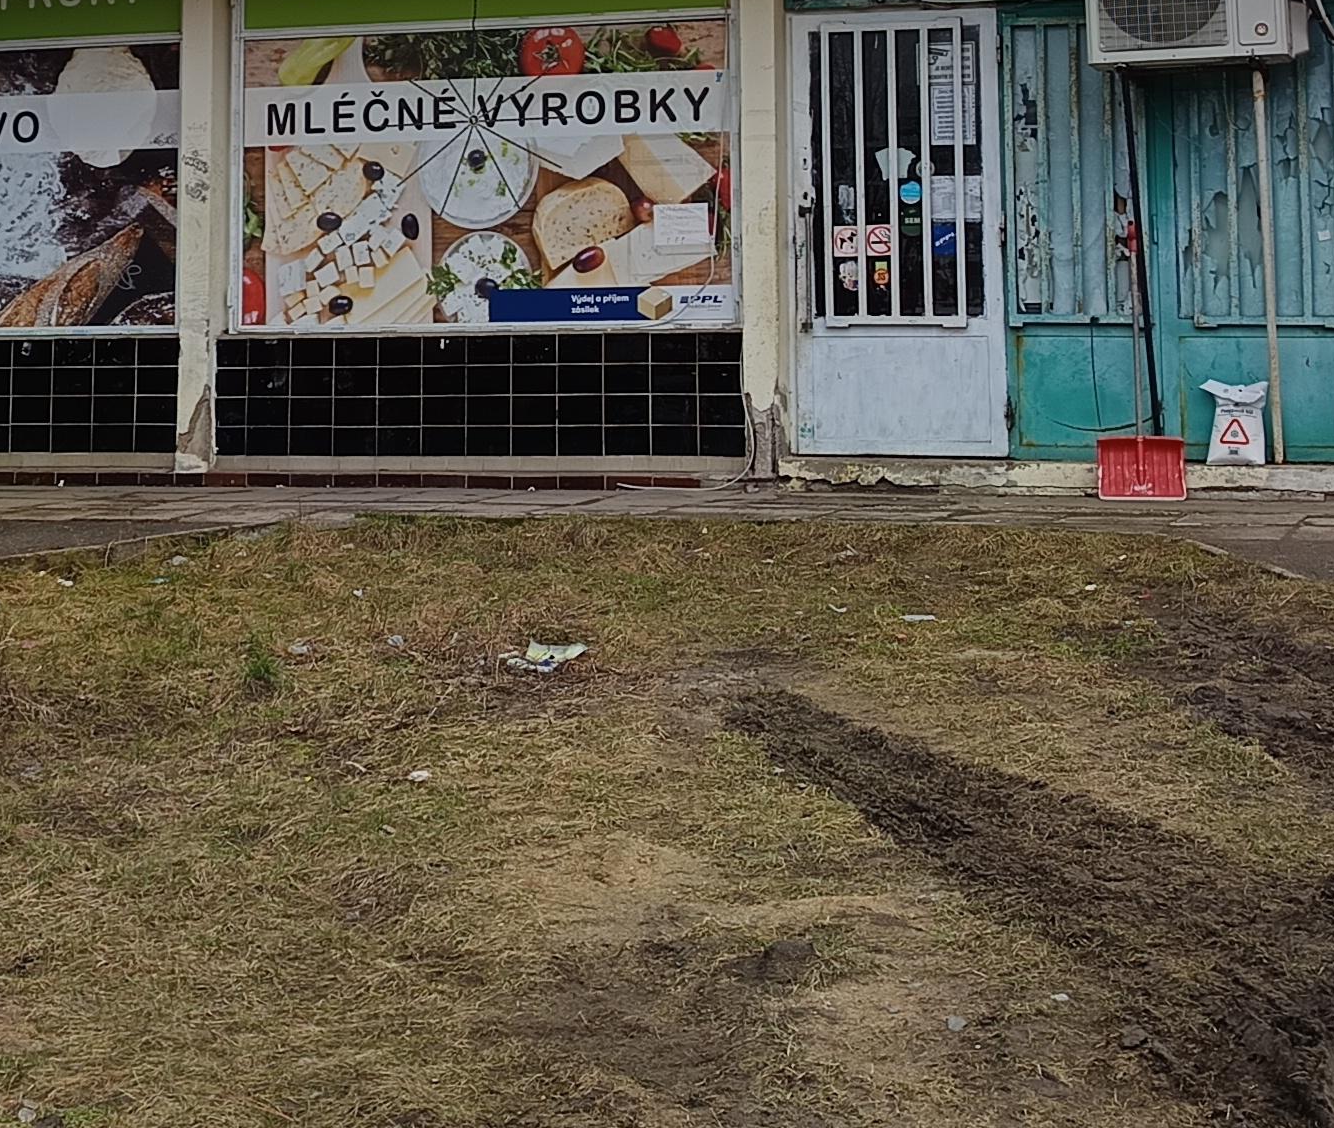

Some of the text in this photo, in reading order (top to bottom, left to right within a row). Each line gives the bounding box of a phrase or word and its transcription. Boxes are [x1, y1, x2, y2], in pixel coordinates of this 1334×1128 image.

[266, 85, 711, 136] MLÉČNÉ VÝROBKY
[571, 294, 594, 304] Výdej
[603, 294, 629, 304] příjem
[571, 305, 599, 313] zásilek
